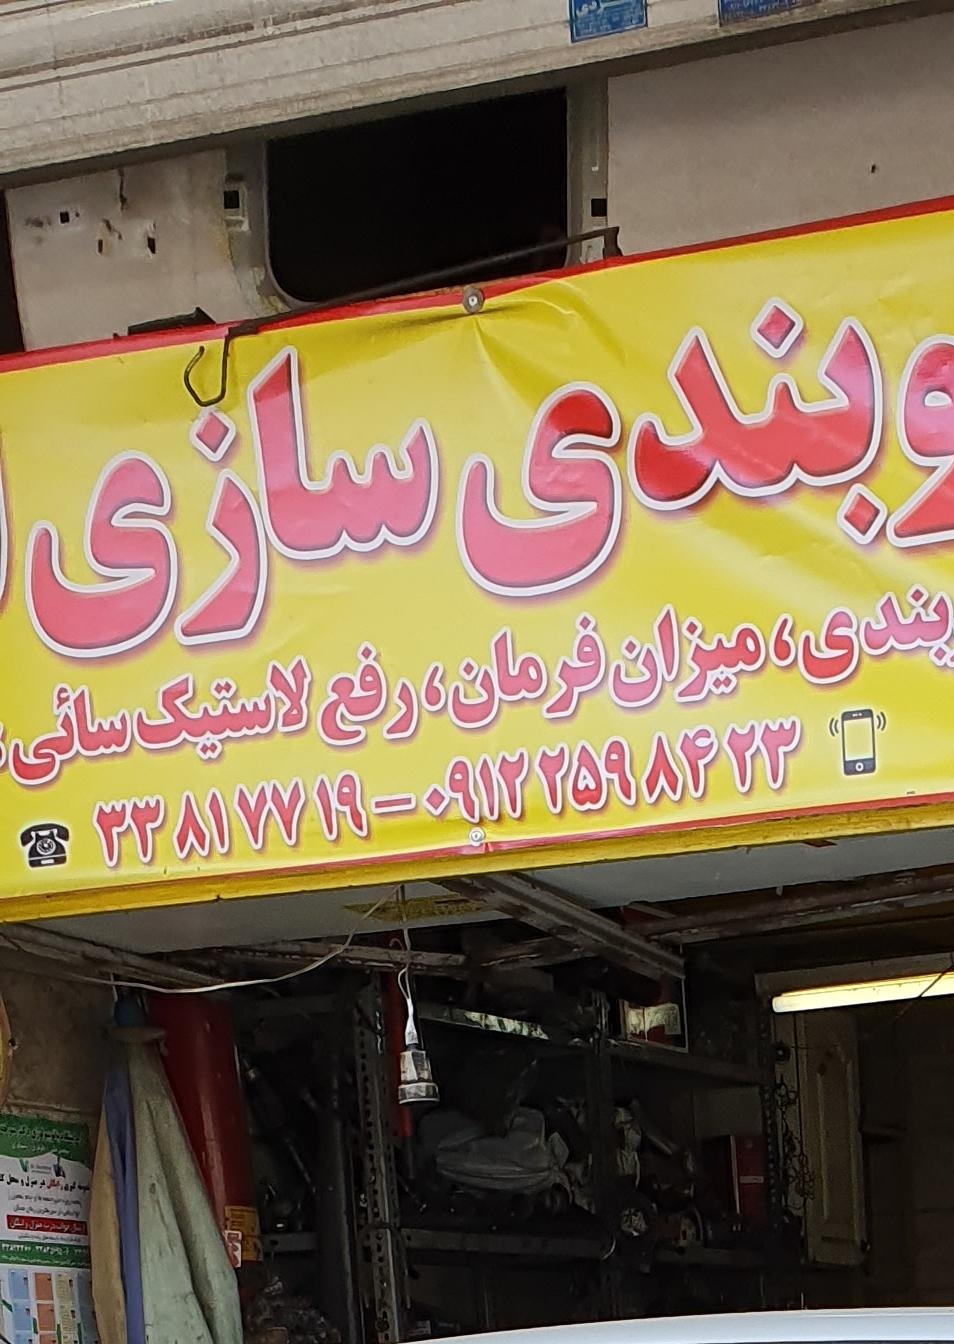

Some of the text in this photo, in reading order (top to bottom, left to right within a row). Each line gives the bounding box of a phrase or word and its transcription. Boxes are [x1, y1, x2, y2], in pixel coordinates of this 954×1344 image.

[26, 345, 438, 658] سازی
[132, 655, 311, 760] لاستیک
[318, 641, 418, 746] رفع
[609, 603, 766, 707] میزان
